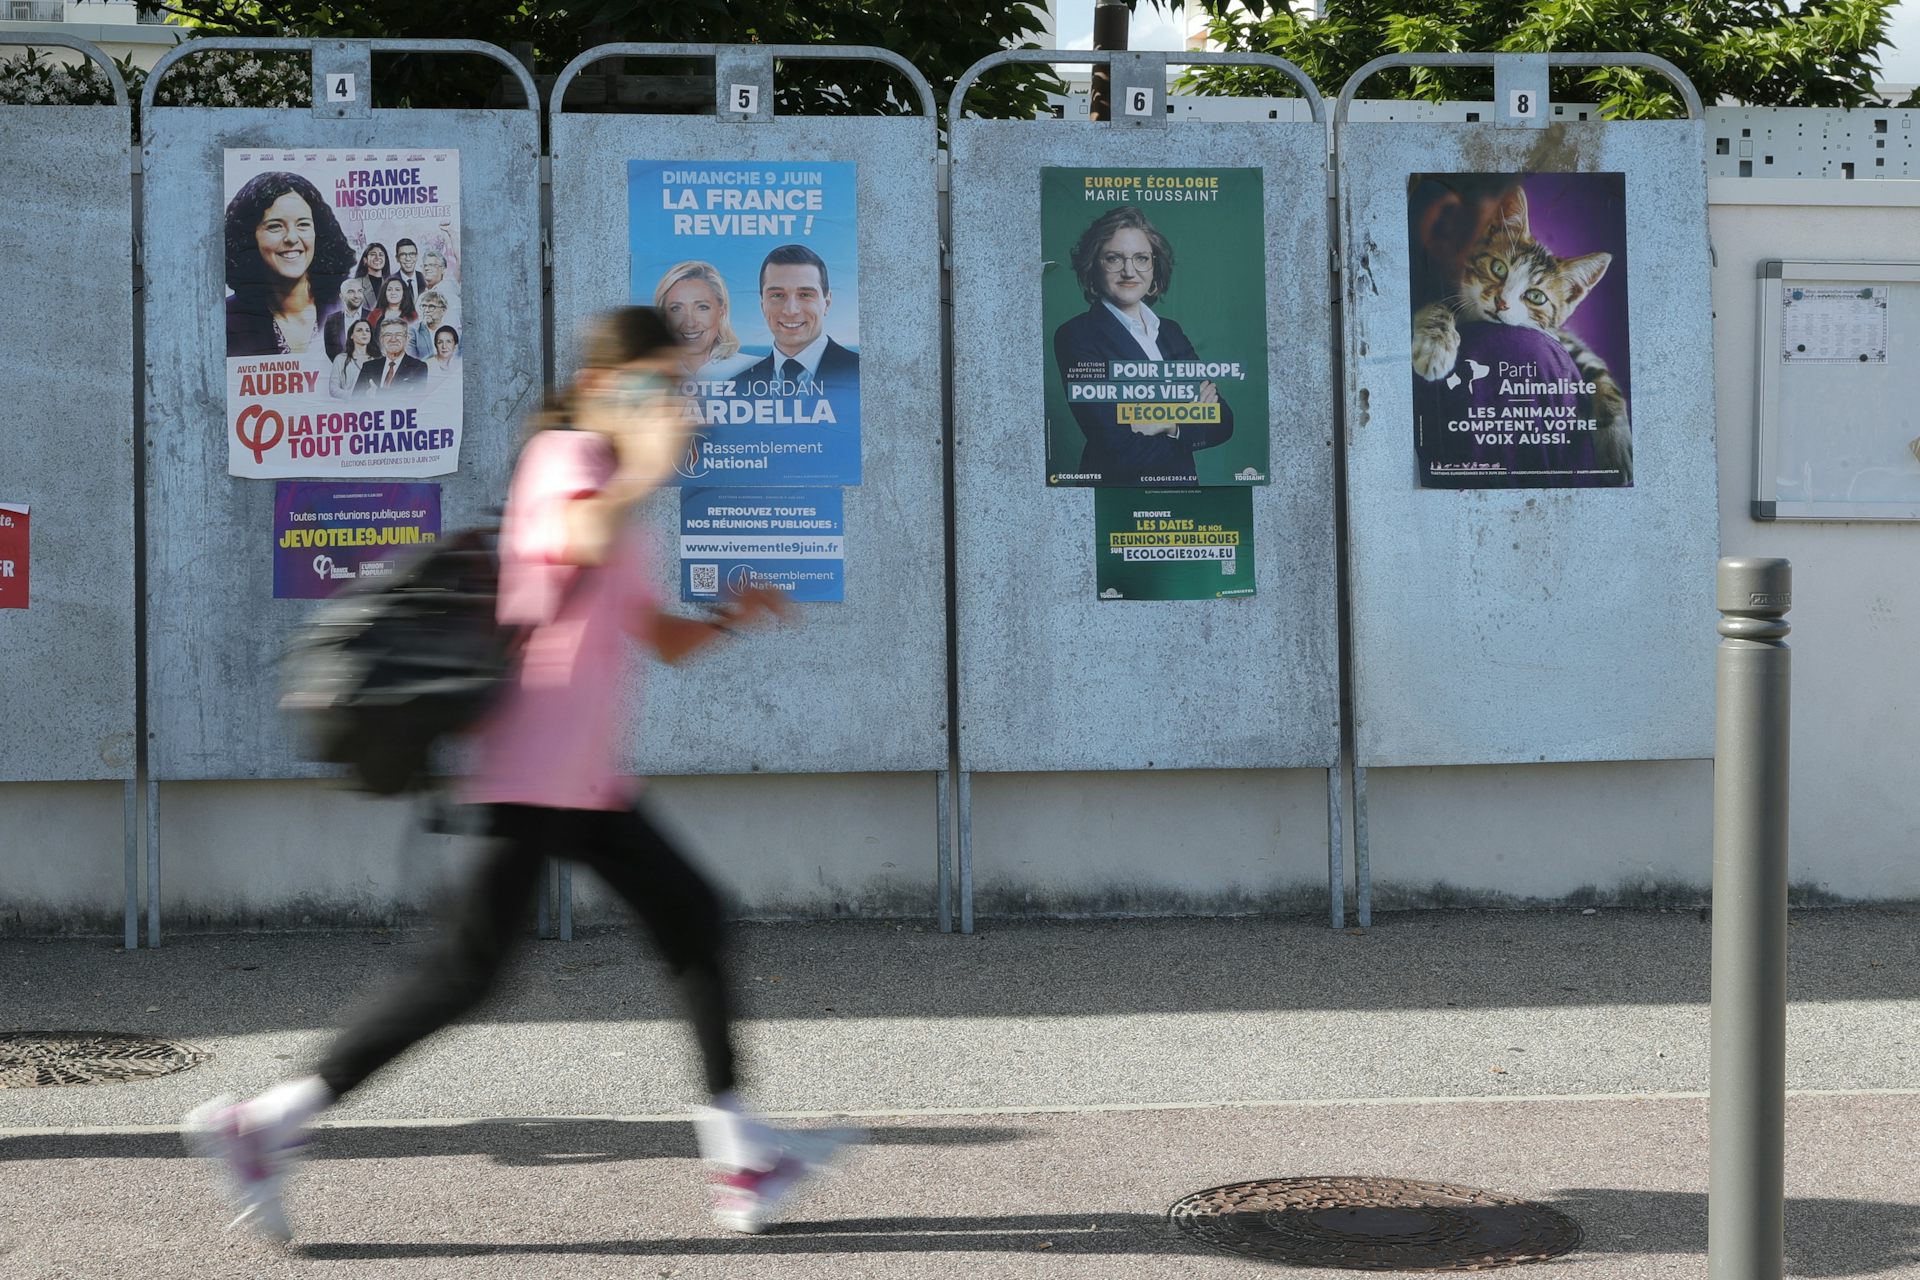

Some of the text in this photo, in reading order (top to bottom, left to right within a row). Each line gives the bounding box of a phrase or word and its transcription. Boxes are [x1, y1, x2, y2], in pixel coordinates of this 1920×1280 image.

[335, 78, 348, 97] 4
[738, 89, 750, 109] 5
[1133, 92, 1146, 111] 6
[1517, 94, 1529, 113] 8
[335, 168, 420, 189] LA FRANCE
[662, 171, 822, 185] DIMANCHE 9 JUIN
[1085, 175, 1219, 188] EUROPE ÉCOLOGIE
[336, 186, 438, 207] INSOUMISE
[663, 189, 823, 211] LA FRANCE
[1085, 190, 1219, 201] MARIE TOUSSAINT
[349, 205, 452, 221] UNION POPULAIRE
[674, 214, 814, 236] REVIENT !
[237, 361, 300, 374] AVEC MANON
[1113, 362, 1246, 381] POUR L'EUROPE,
[1499, 361, 1537, 377] Parti
[239, 371, 320, 397] AUBRY
[680, 380, 824, 397] OTEZ JORDAN
[1499, 378, 1597, 395] Animaliste
[1072, 384, 1199, 402] POUR NOS VIES,
[681, 399, 837, 425] ARDELLA
[1121, 403, 1217, 421] L'ÉCOLOGIE
[1468, 406, 1577, 419] LES ANIMAUX
[288, 408, 418, 437] LA FORCE DE
[1448, 419, 1597, 434] COMPTENT, VOTRE
[288, 428, 454, 459] TOUT CHANGER
[1475, 433, 1571, 445] VOIX AUSSI.
[703, 441, 823, 455] Rassemblement
[703, 456, 768, 470] National
[289, 509, 427, 522] Toutes nos réunions publiques sur
[707, 507, 817, 517] RETROUVEZ TOUTES
[686, 519, 710, 529] NOS
[712, 518, 769, 529] RÉUNIONS
[771, 519, 832, 529] PUBLIQUES
[1136, 520, 1156, 531] LES
[1159, 519, 1194, 530] DATES
[279, 526, 435, 548] JEVOTELE9JUIN.FR
[1174, 533, 1238, 544] PUBLIQUES
[686, 541, 838, 555] www.vivementle9juin.fr
[1126, 548, 1233, 560] ECOLOGIE2024.EU
[0, 560, 15, 577] R
[750, 571, 834, 580] Rassemblement
